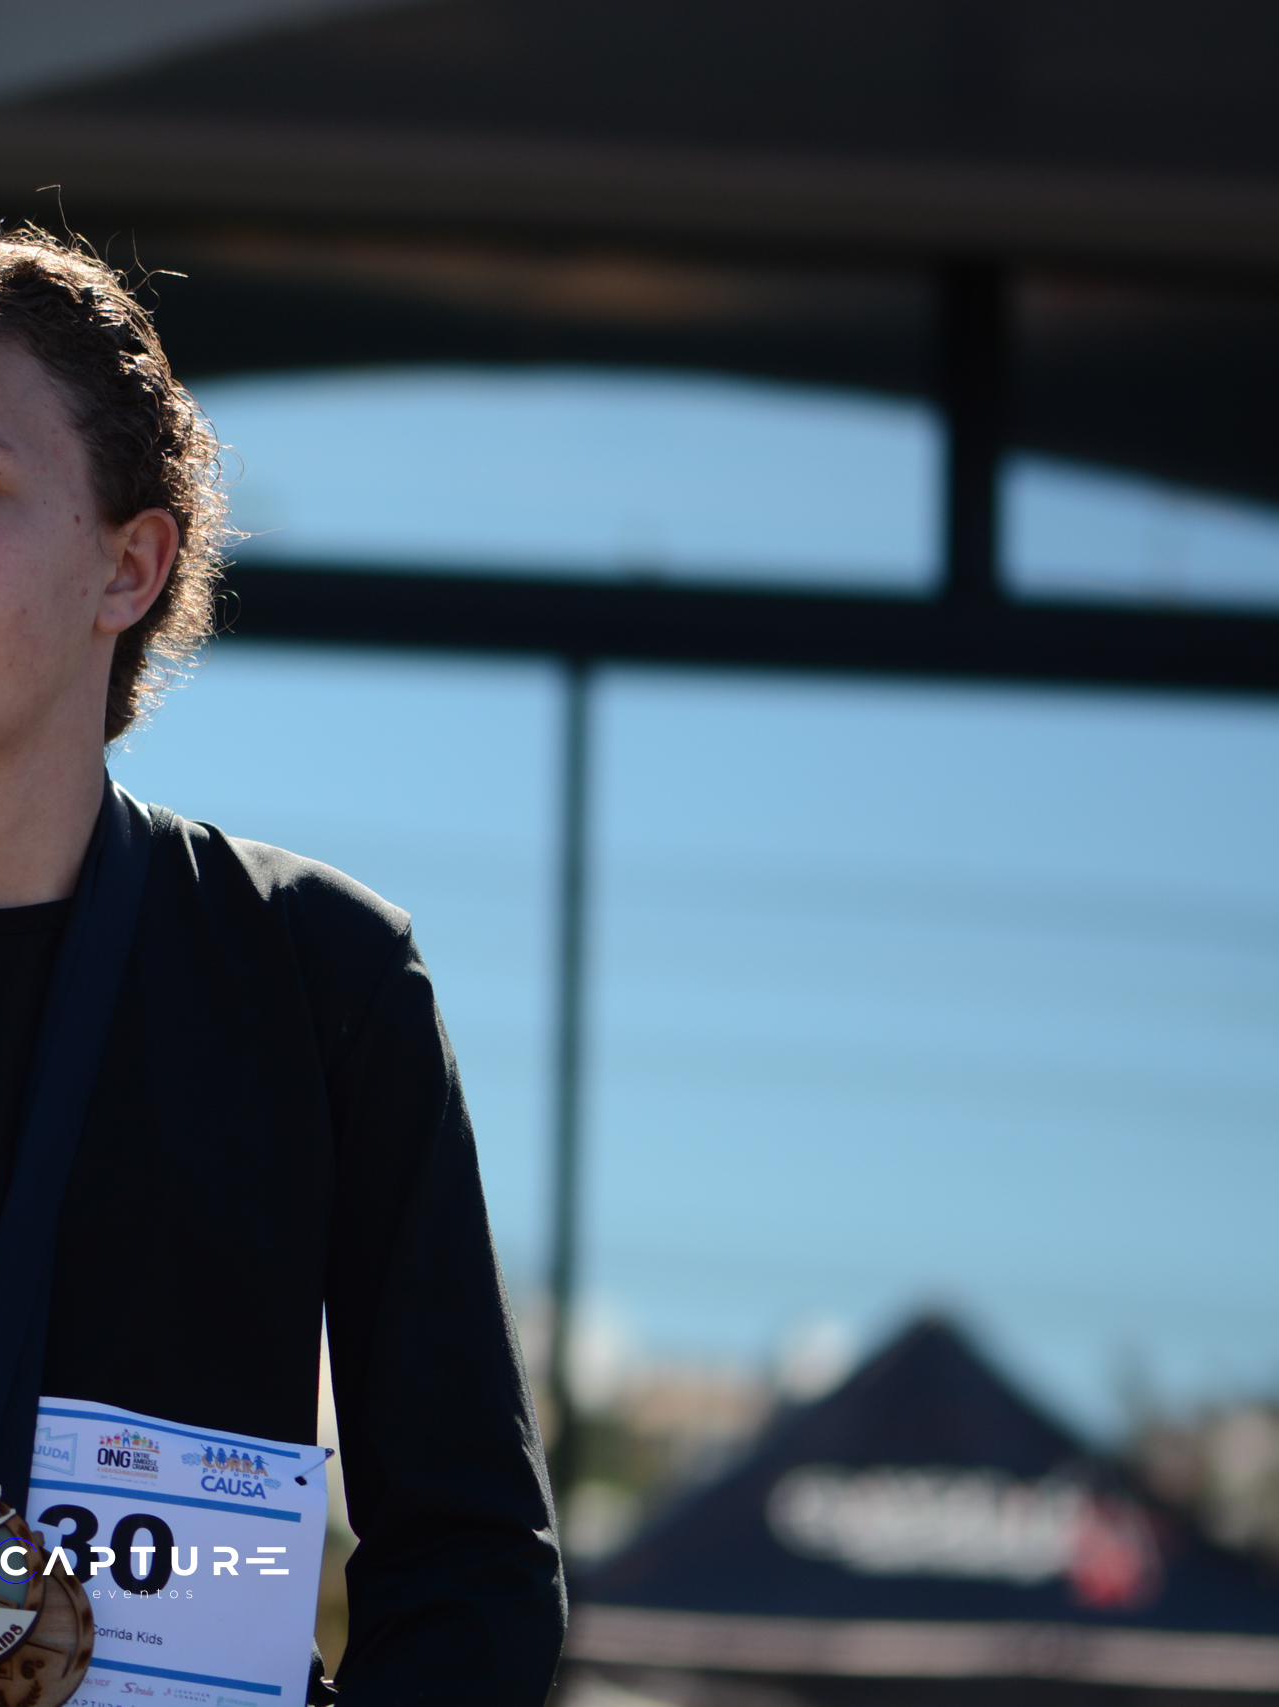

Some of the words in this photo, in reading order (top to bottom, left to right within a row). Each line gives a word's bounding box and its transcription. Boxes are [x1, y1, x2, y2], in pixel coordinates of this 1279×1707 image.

[34, 1445, 70, 1461] JUDA
[97, 1447, 131, 1468] ONG
[202, 1453, 269, 1477] CORRA
[203, 1467, 225, 1475] por
[234, 1470, 259, 1480] uma
[201, 1475, 267, 1500] CAUSA
[37, 1504, 175, 1596] 30
[136, 1630, 163, 1646] Kids
